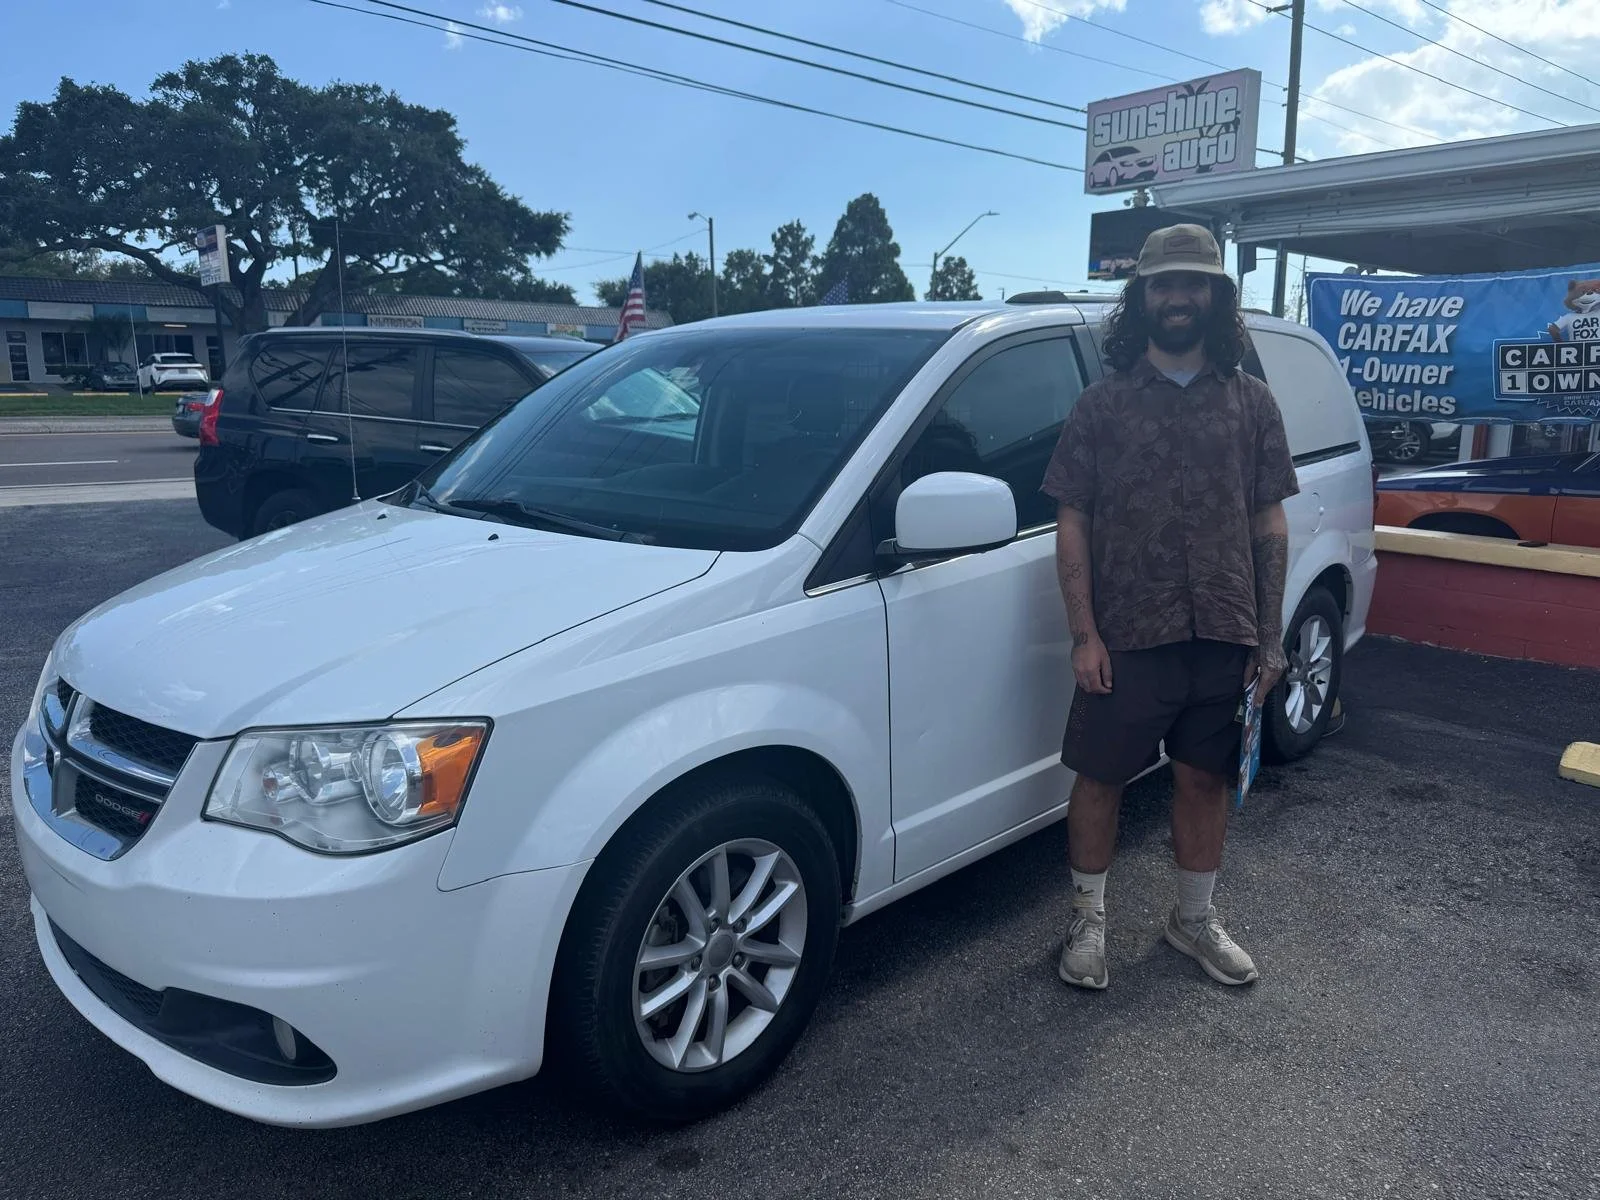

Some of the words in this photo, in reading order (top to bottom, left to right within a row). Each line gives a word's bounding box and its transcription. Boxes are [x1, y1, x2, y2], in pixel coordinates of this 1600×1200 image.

[1093, 86, 1239, 148] sunshine
[1162, 131, 1238, 172] auto
[1340, 288, 1380, 317] We
[1386, 291, 1464, 318] have
[1337, 322, 1457, 354] CARFAX
[1572, 317, 1600, 330] CAR
[1573, 328, 1599, 340] FOX
[1351, 385, 1456, 415] ehicles
[95, 793, 141, 819] DODGE
